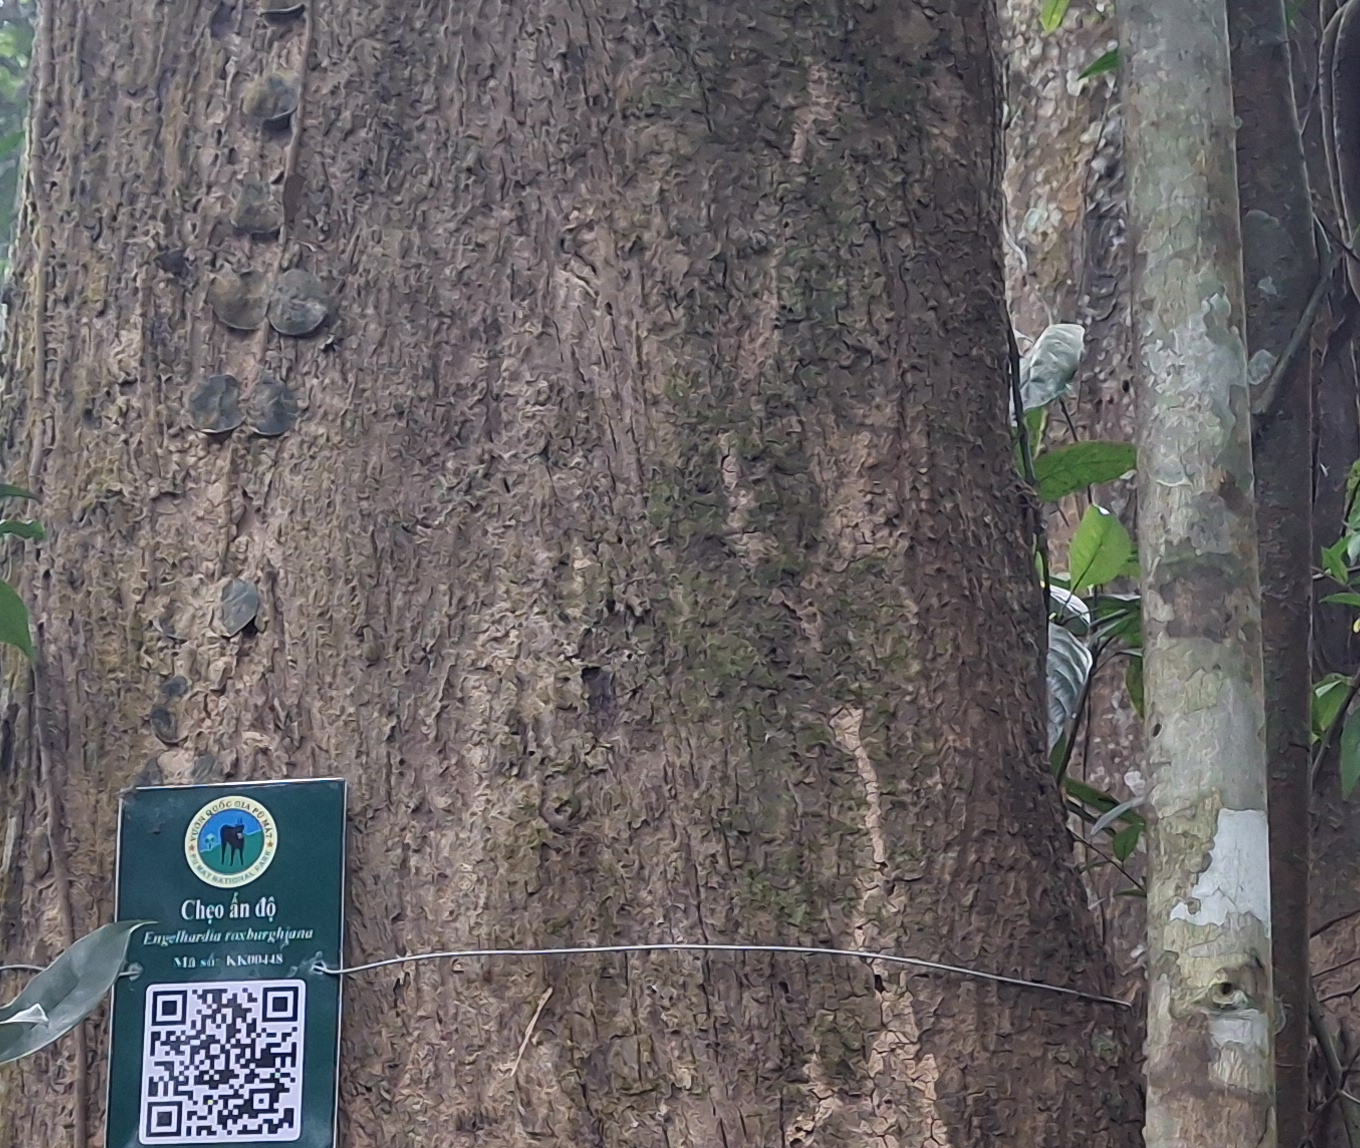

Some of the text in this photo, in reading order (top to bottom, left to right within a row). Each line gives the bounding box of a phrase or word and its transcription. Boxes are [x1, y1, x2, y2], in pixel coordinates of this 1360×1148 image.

[206, 800, 232, 816] QUỐC
[211, 872, 253, 884] NATIONAL
[181, 892, 276, 925] Chẹo ấn độ
[143, 929, 222, 947] Engelhardia
[226, 953, 283, 967] KK00448
